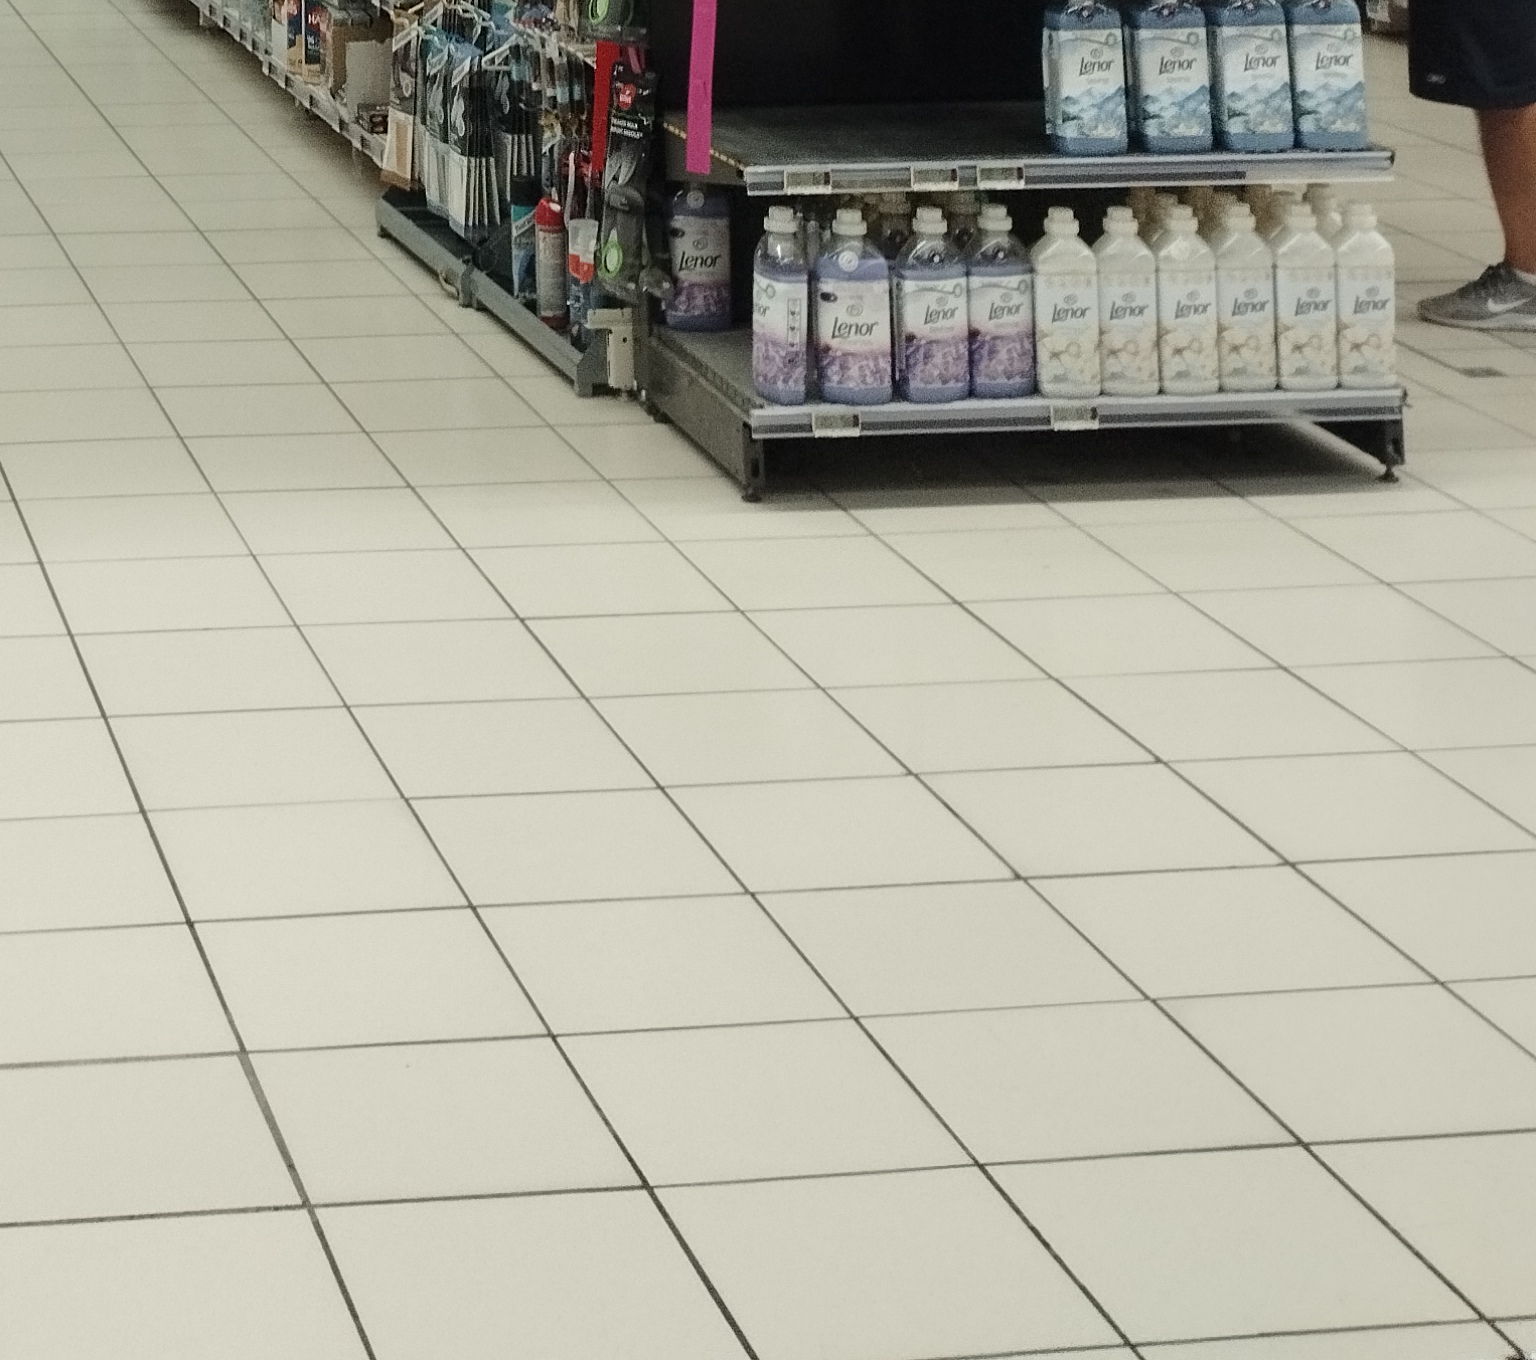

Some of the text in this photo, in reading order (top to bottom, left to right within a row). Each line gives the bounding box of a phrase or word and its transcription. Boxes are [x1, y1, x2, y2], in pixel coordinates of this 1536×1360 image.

[1079, 56, 1113, 76] Lenor
[1159, 56, 1196, 75] Lenor
[1244, 53, 1280, 72] Lenor
[1315, 51, 1353, 70] Lenor
[679, 250, 720, 272] Lenor
[924, 304, 958, 325] Lenor
[988, 301, 1023, 321] Lenor
[1052, 303, 1090, 323] Lenor
[1110, 301, 1148, 321] Lenor
[1175, 299, 1211, 319] Lenor
[1232, 298, 1268, 317] Lenor
[1295, 295, 1332, 316] Lenor
[1353, 295, 1389, 314] Lenor
[832, 316, 879, 339] Lenor
